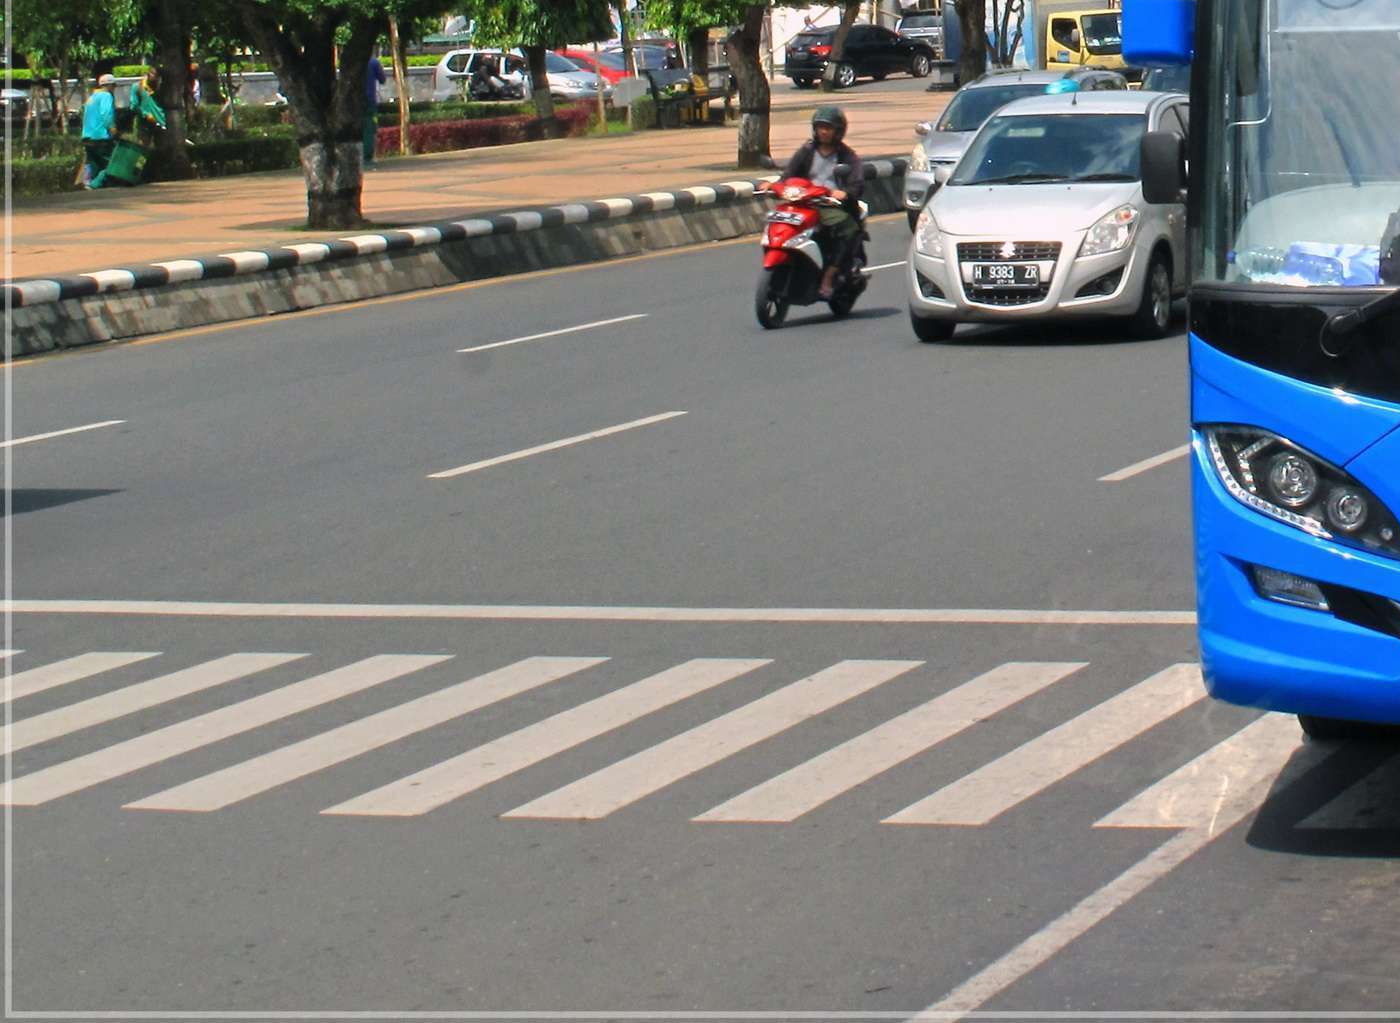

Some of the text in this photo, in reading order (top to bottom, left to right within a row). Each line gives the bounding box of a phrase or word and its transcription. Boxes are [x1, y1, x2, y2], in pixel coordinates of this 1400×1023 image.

[975, 266, 1037, 279] H 9383 ZR
